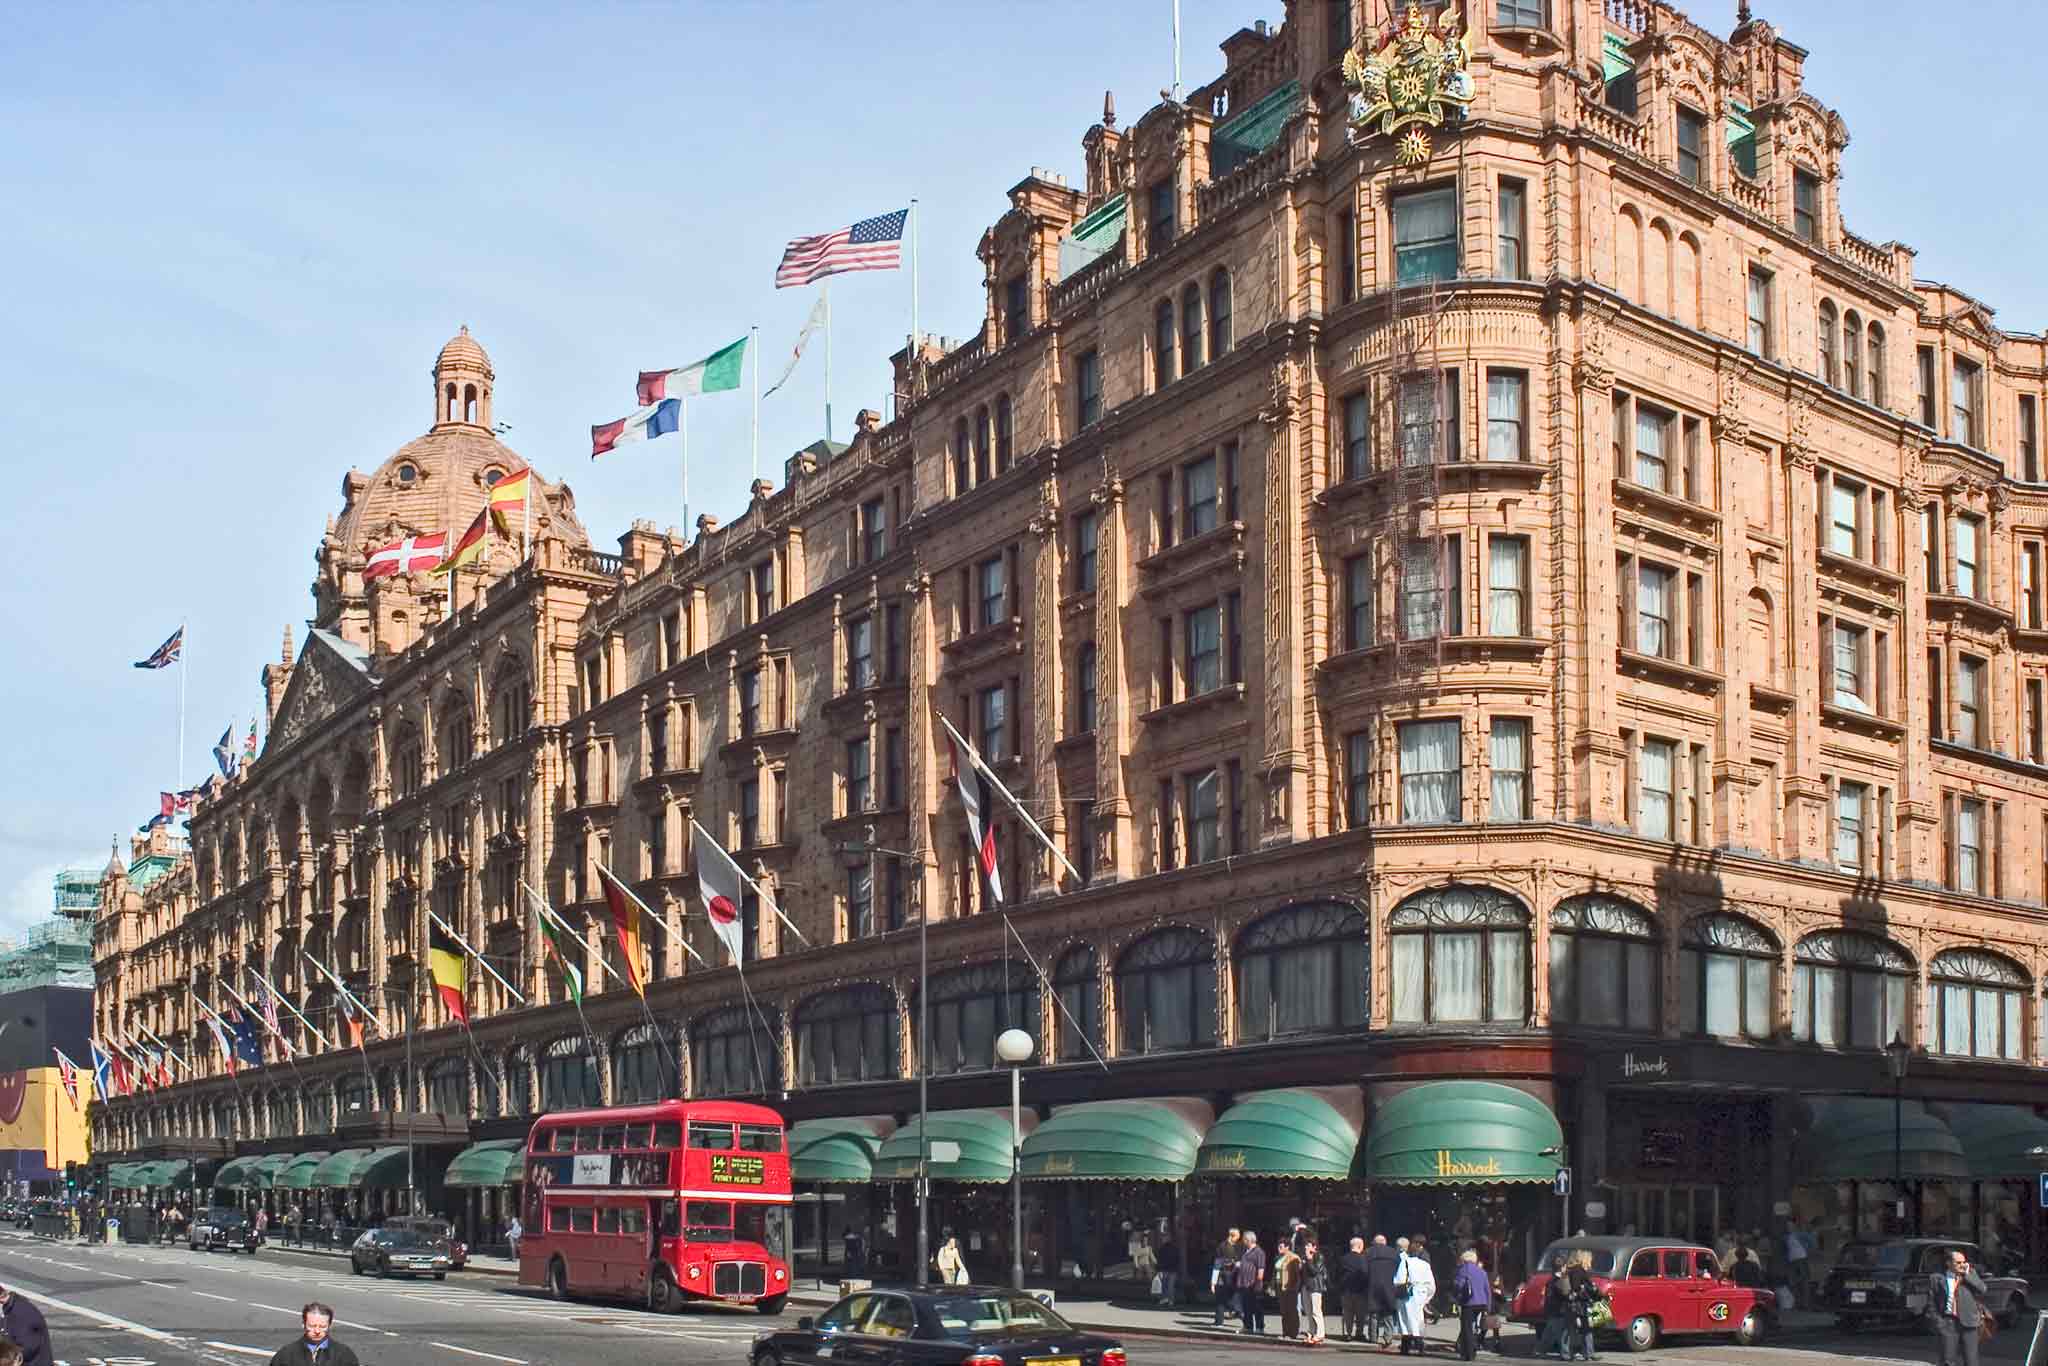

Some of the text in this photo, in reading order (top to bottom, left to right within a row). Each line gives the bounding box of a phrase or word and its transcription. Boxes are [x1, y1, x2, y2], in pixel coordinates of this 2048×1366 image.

[1621, 1053, 1669, 1076] Harrods
[713, 1156, 726, 1168] 14
[1434, 1150, 1502, 1177] Harrods
